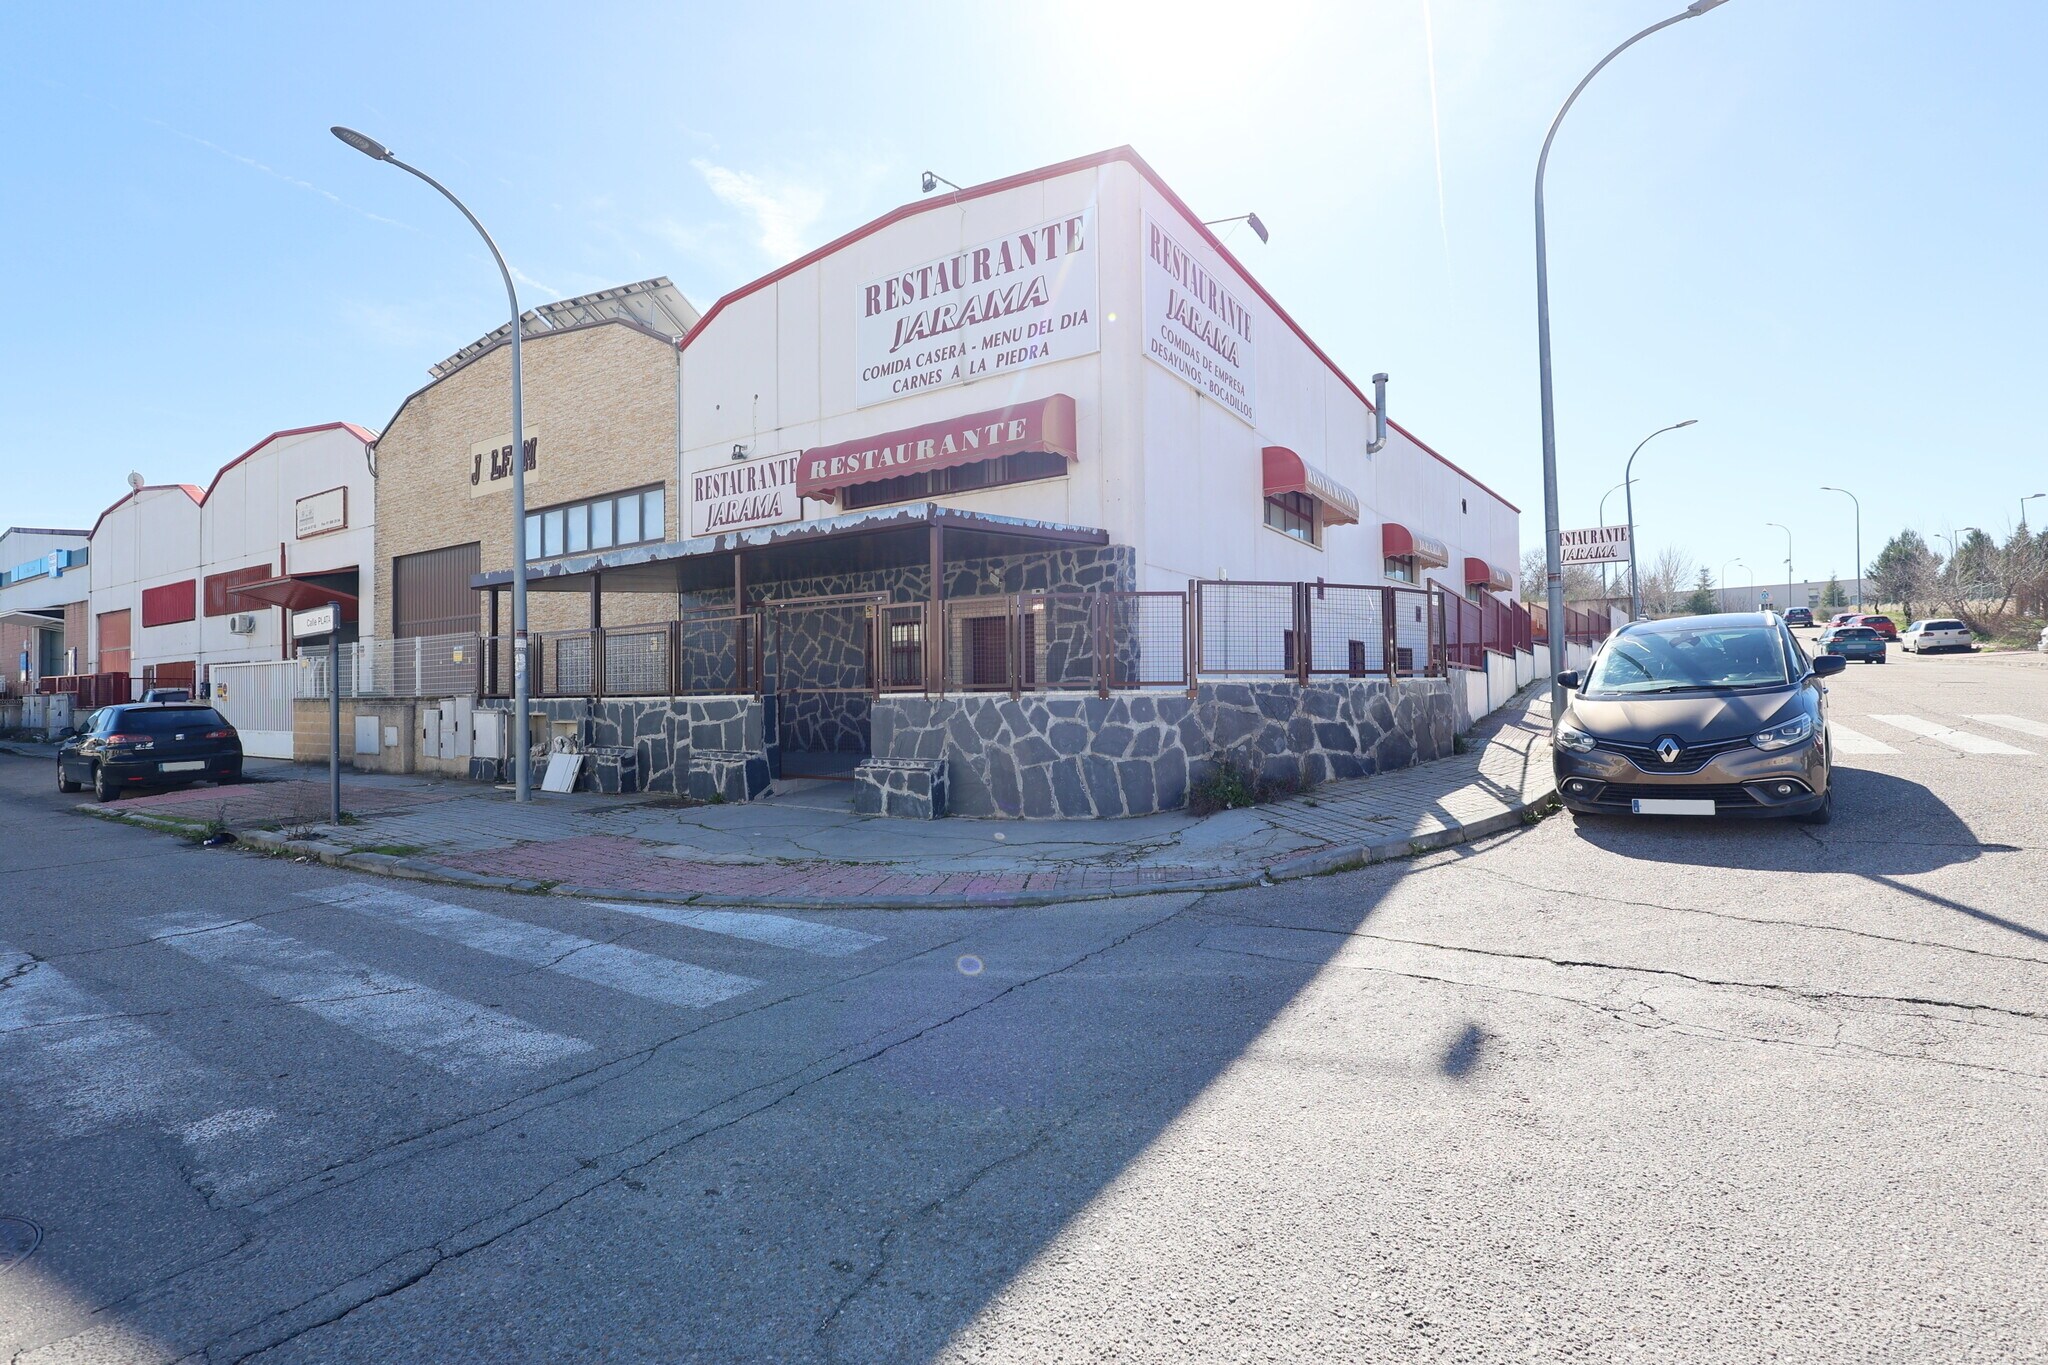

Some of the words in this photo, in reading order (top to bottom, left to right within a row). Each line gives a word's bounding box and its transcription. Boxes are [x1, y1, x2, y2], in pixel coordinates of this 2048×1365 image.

[865, 215, 1084, 318] RESTAURANTE
[1150, 221, 1252, 344] RESTAURANTE
[862, 359, 911, 382] COMIDA
[916, 342, 967, 367] CASERA
[981, 326, 1023, 350] MENU
[1027, 318, 1054, 338] DEL
[1060, 309, 1088, 330] DIA
[889, 275, 1049, 353] JARAMA
[1166, 289, 1239, 368] JARAMA
[892, 369, 942, 393] CARNES
[951, 365, 960, 379] A
[969, 358, 986, 374] LA
[996, 342, 1049, 368] PIEDRA
[1151, 338, 1201, 385] DESAYUNOS
[1209, 380, 1253, 419] BOCADILLOS
[1161, 325, 1200, 364] COMIDAS
[1202, 356, 1212, 373] DE
[1214, 365, 1245, 396] EMPRESA
[695, 457, 798, 502] RESTAURANTE
[809, 417, 1027, 480] RESTAURANTE
[705, 492, 783, 532] JARAMA
[1306, 468, 1356, 511] RESTAURANTE
[1560, 527, 1627, 546] ESTAURANTE
[1561, 545, 1617, 563] JARAMA
